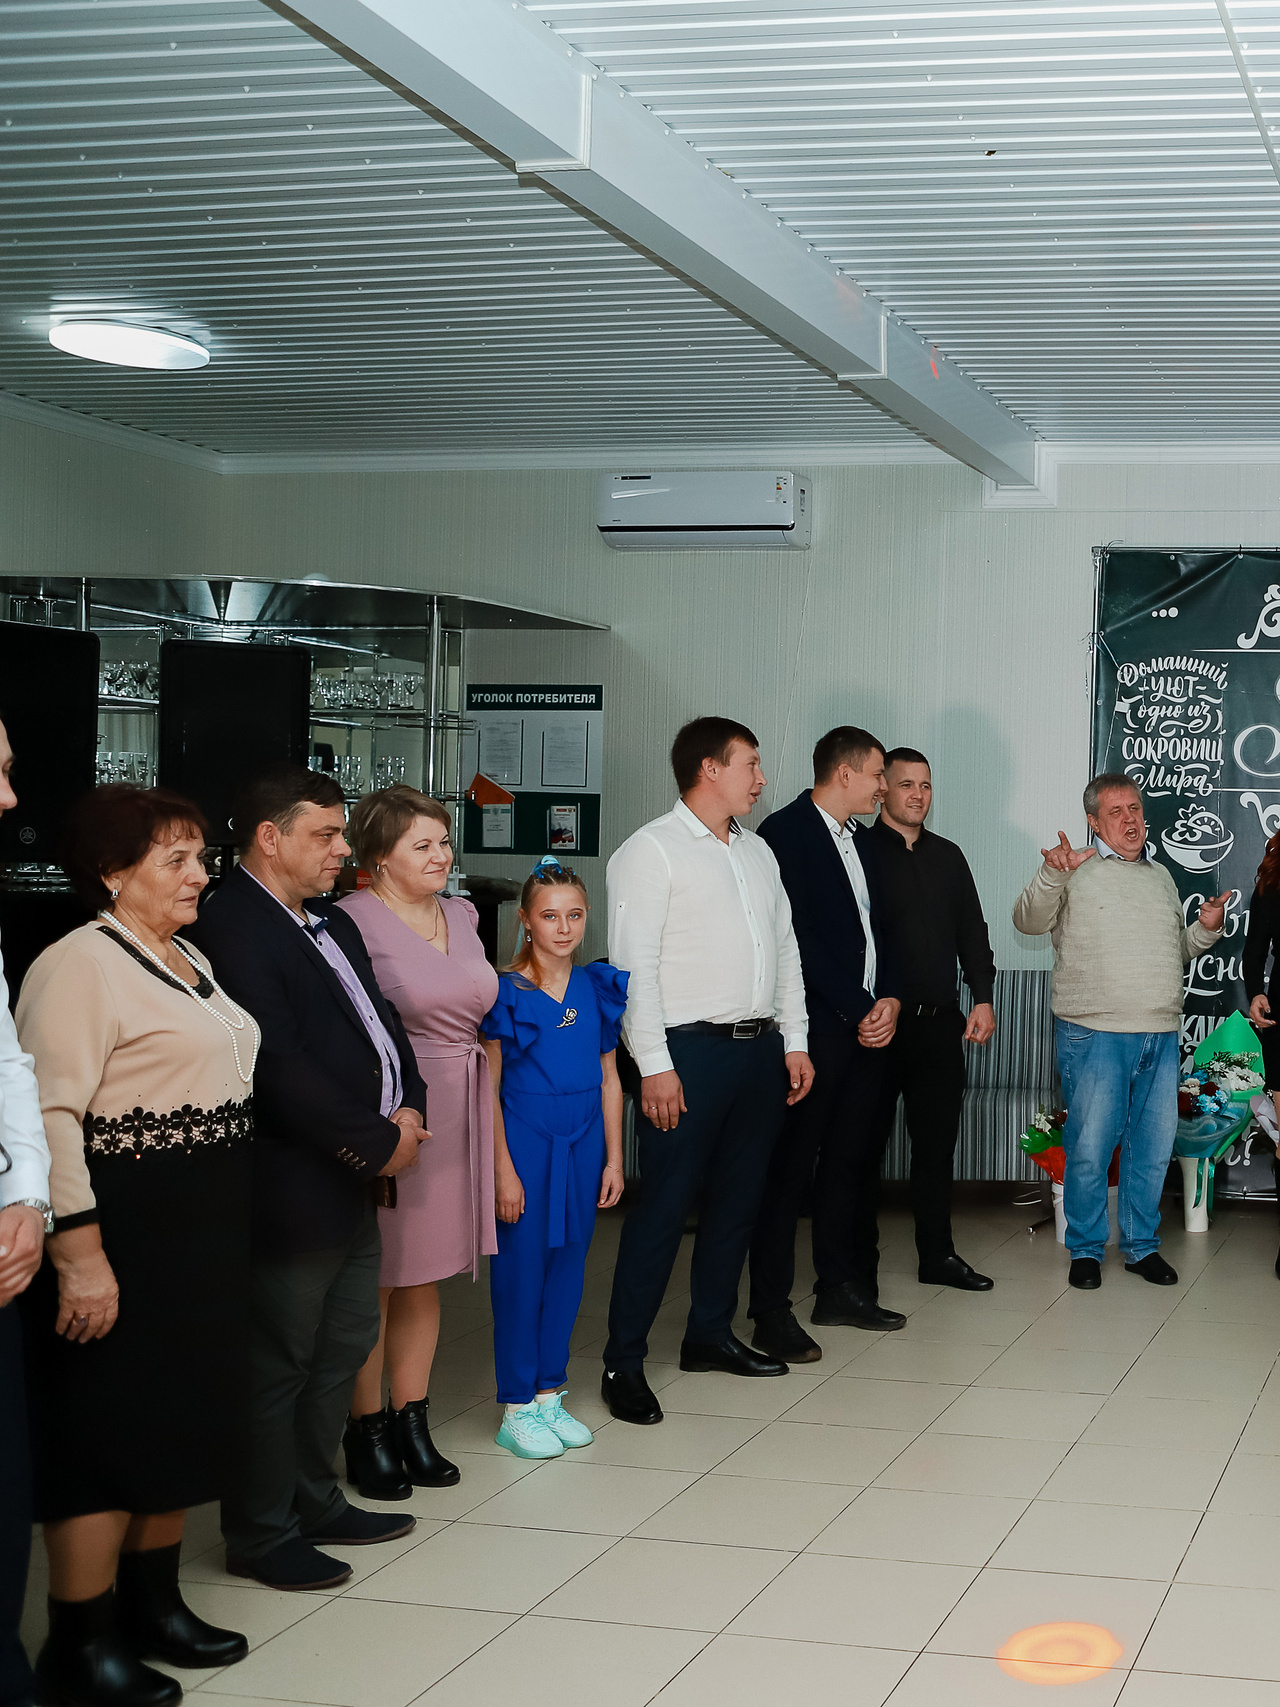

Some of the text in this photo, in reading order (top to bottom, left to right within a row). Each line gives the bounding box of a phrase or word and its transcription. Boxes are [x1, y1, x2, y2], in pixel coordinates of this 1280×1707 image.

[1117, 656, 1228, 690] Домашний
[471, 693, 596, 704] УГОЛОК ПОТРЕБИТЕЛЯ
[1138, 704, 1184, 733] одно
[1122, 737, 1224, 765] СОКРОВИЩ
[1133, 764, 1213, 796] Мира
